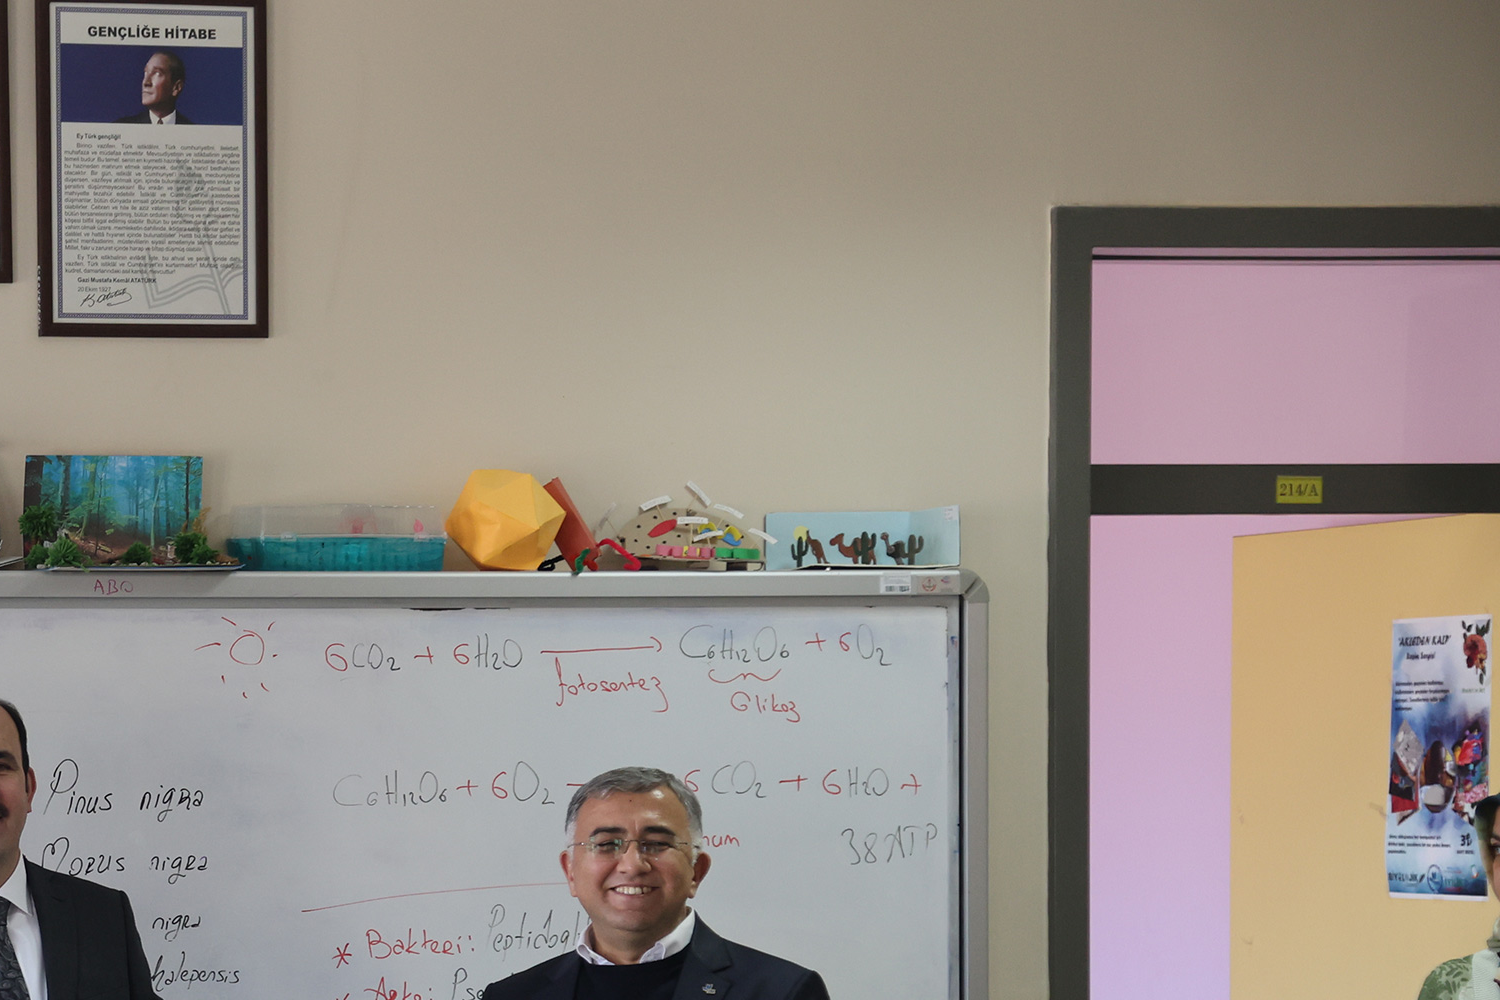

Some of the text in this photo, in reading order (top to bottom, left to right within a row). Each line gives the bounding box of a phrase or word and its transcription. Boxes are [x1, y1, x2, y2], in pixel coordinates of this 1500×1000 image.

[88, 25, 216, 41] GENÇLİĞE HİTABE
[1279, 483, 1319, 497] 214/A
[555, 654, 669, 713] fotosentez
[43, 759, 114, 815] Pinus
